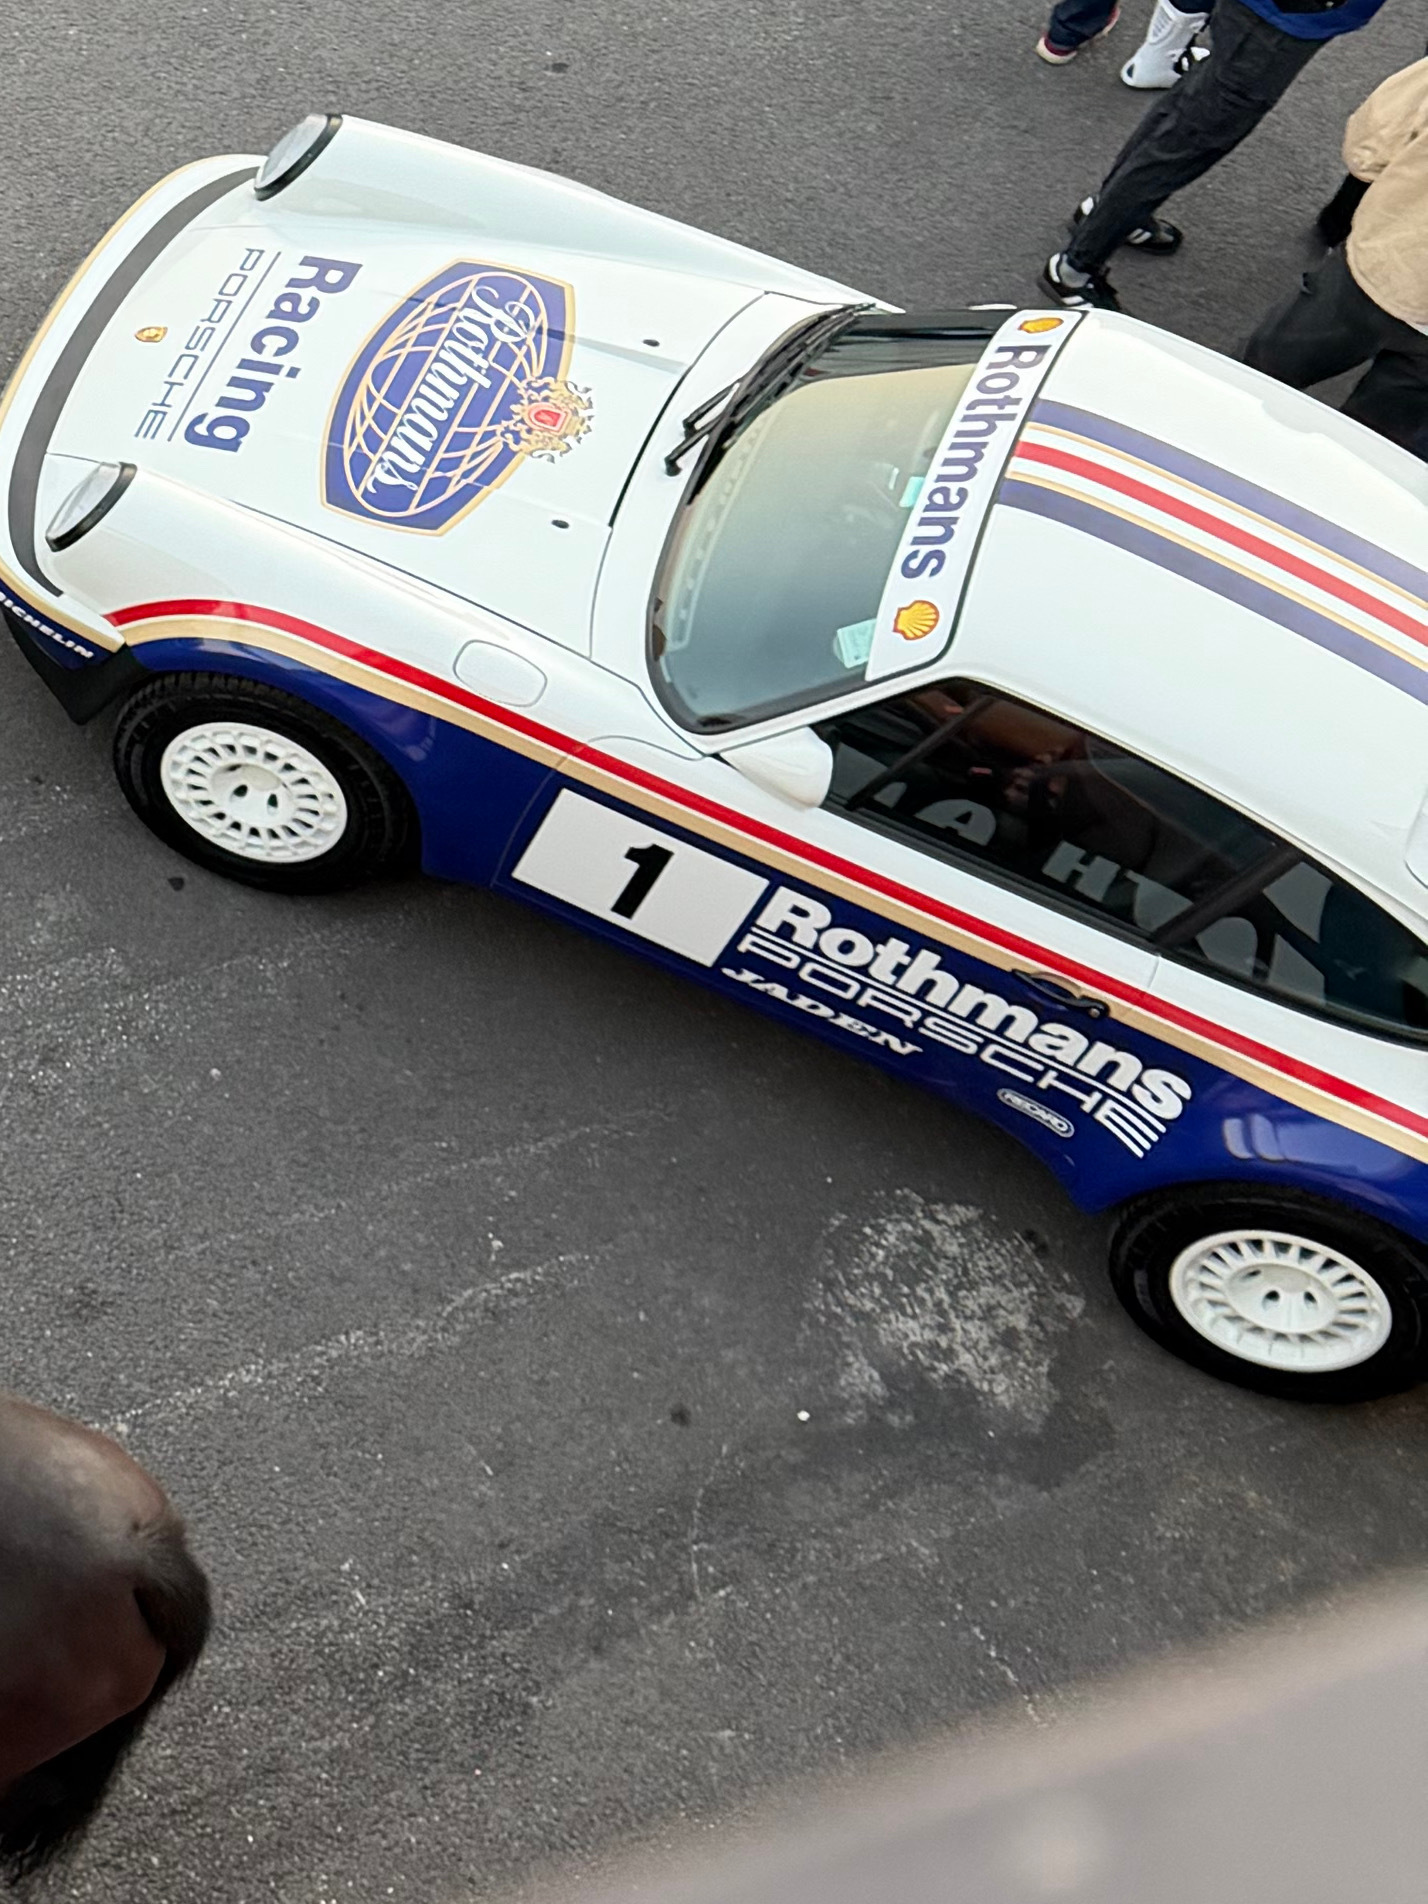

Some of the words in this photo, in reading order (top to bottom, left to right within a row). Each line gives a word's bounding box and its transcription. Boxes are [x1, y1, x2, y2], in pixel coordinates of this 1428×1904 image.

[134, 248, 266, 440] PORSCHE
[184, 255, 364, 453] Racing
[366, 284, 536, 494] Rothmans
[901, 344, 1053, 580] Rothmans
[610, 843, 675, 920] 1
[721, 967, 923, 1056] JADEN
[737, 932, 1167, 1159] PORSCHE
[754, 885, 1193, 1121] Rothmans
